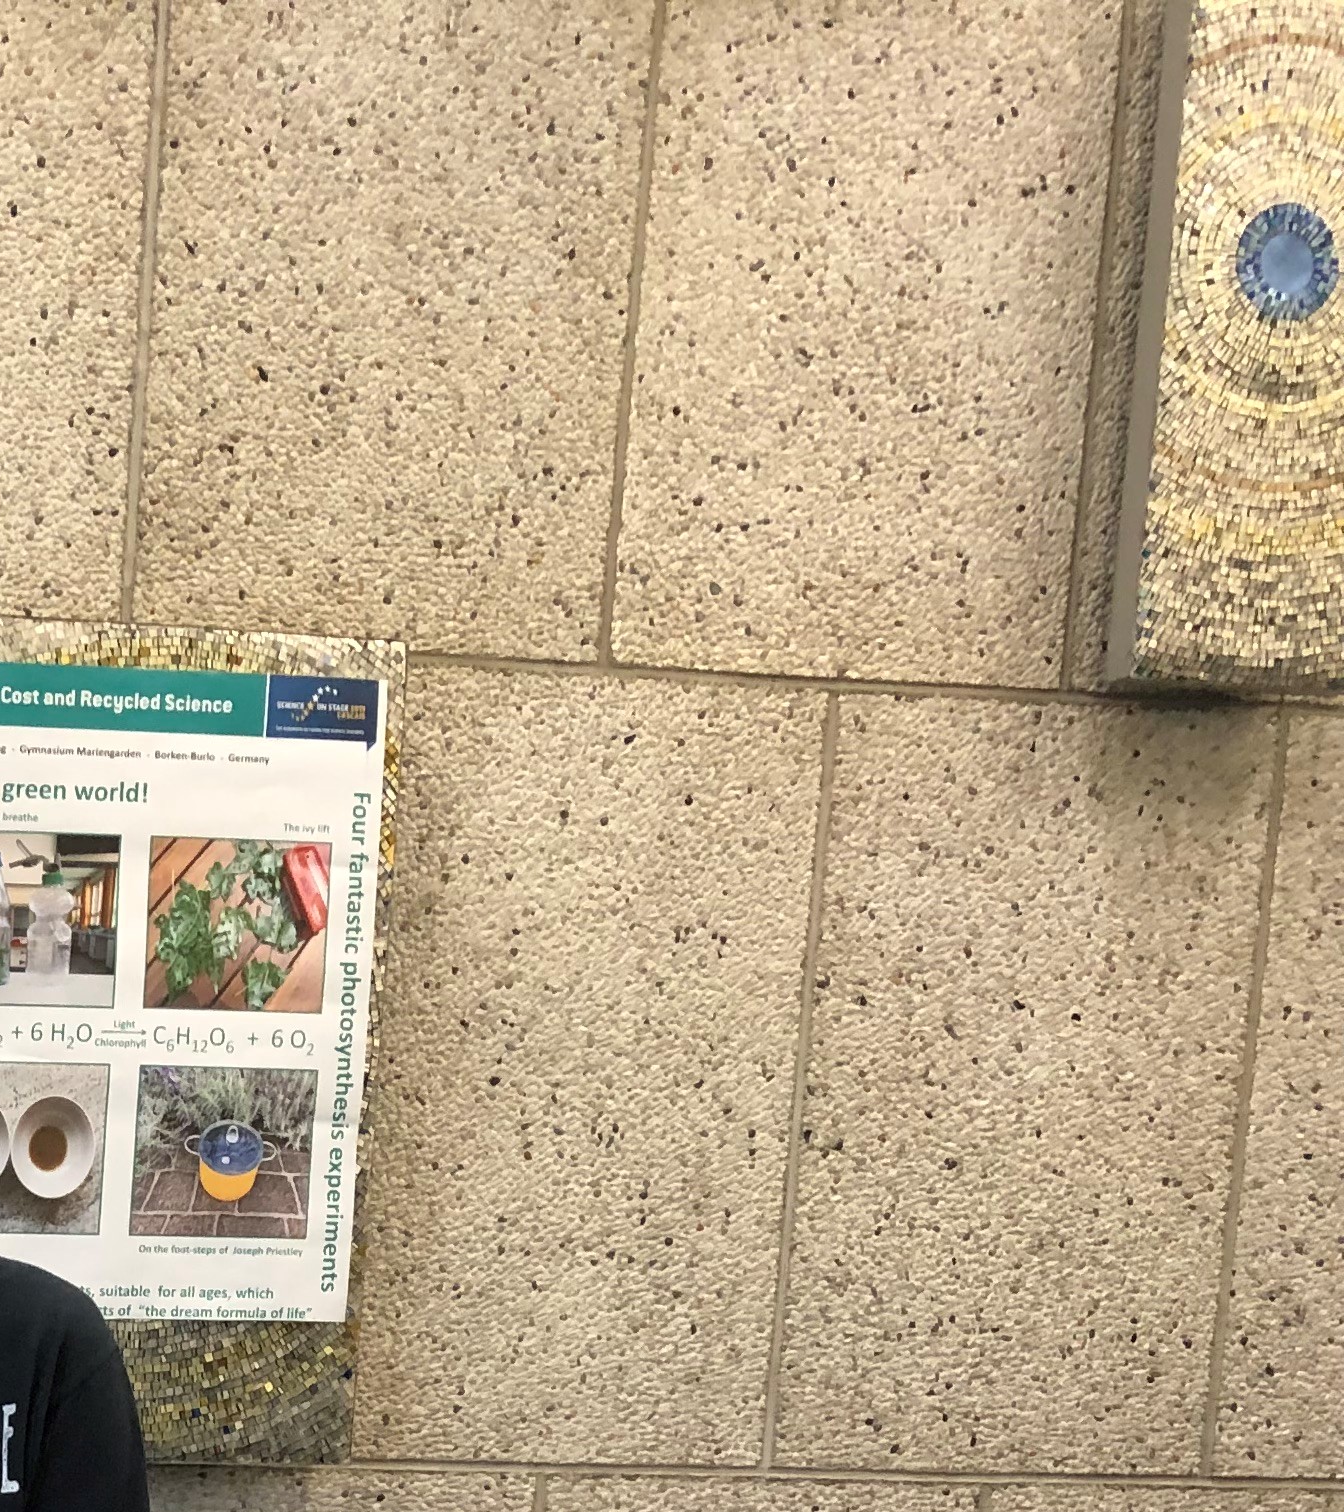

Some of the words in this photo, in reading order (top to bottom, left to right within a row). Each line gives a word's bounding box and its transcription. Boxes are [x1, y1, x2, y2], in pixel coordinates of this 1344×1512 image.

[44, 689, 76, 707] and
[81, 690, 161, 714] Recycled
[165, 693, 234, 714] Science
[19, 744, 74, 757] Gymnasium
[77, 747, 142, 760] Mariengarden
[228, 753, 270, 766] Germany
[2, 782, 67, 803] green
[74, 780, 149, 804] world!
[2, 812, 39, 822] breathe
[351, 792, 372, 845] Four
[283, 823, 301, 833] The
[344, 852, 370, 955] fantastic
[30, 1022, 43, 1041] 6
[113, 1019, 136, 1031] Light
[271, 1028, 284, 1049] 6
[331, 961, 362, 1140] photosynthesis
[320, 1147, 344, 1293] experiments
[138, 1244, 152, 1254] On
[154, 1245, 169, 1254] the
[219, 1246, 229, 1255] of
[232, 1247, 264, 1257] Joseph
[266, 1247, 304, 1258] Priestley
[99, 1285, 150, 1298] suitable
[158, 1286, 176, 1298] for
[180, 1287, 196, 1299] all
[199, 1289, 232, 1301] ages,
[236, 1288, 275, 1300] which
[117, 1304, 132, 1316] of
[170, 1306, 213, 1318] dream
[216, 1306, 267, 1319] formula
[271, 1307, 284, 1319] of
